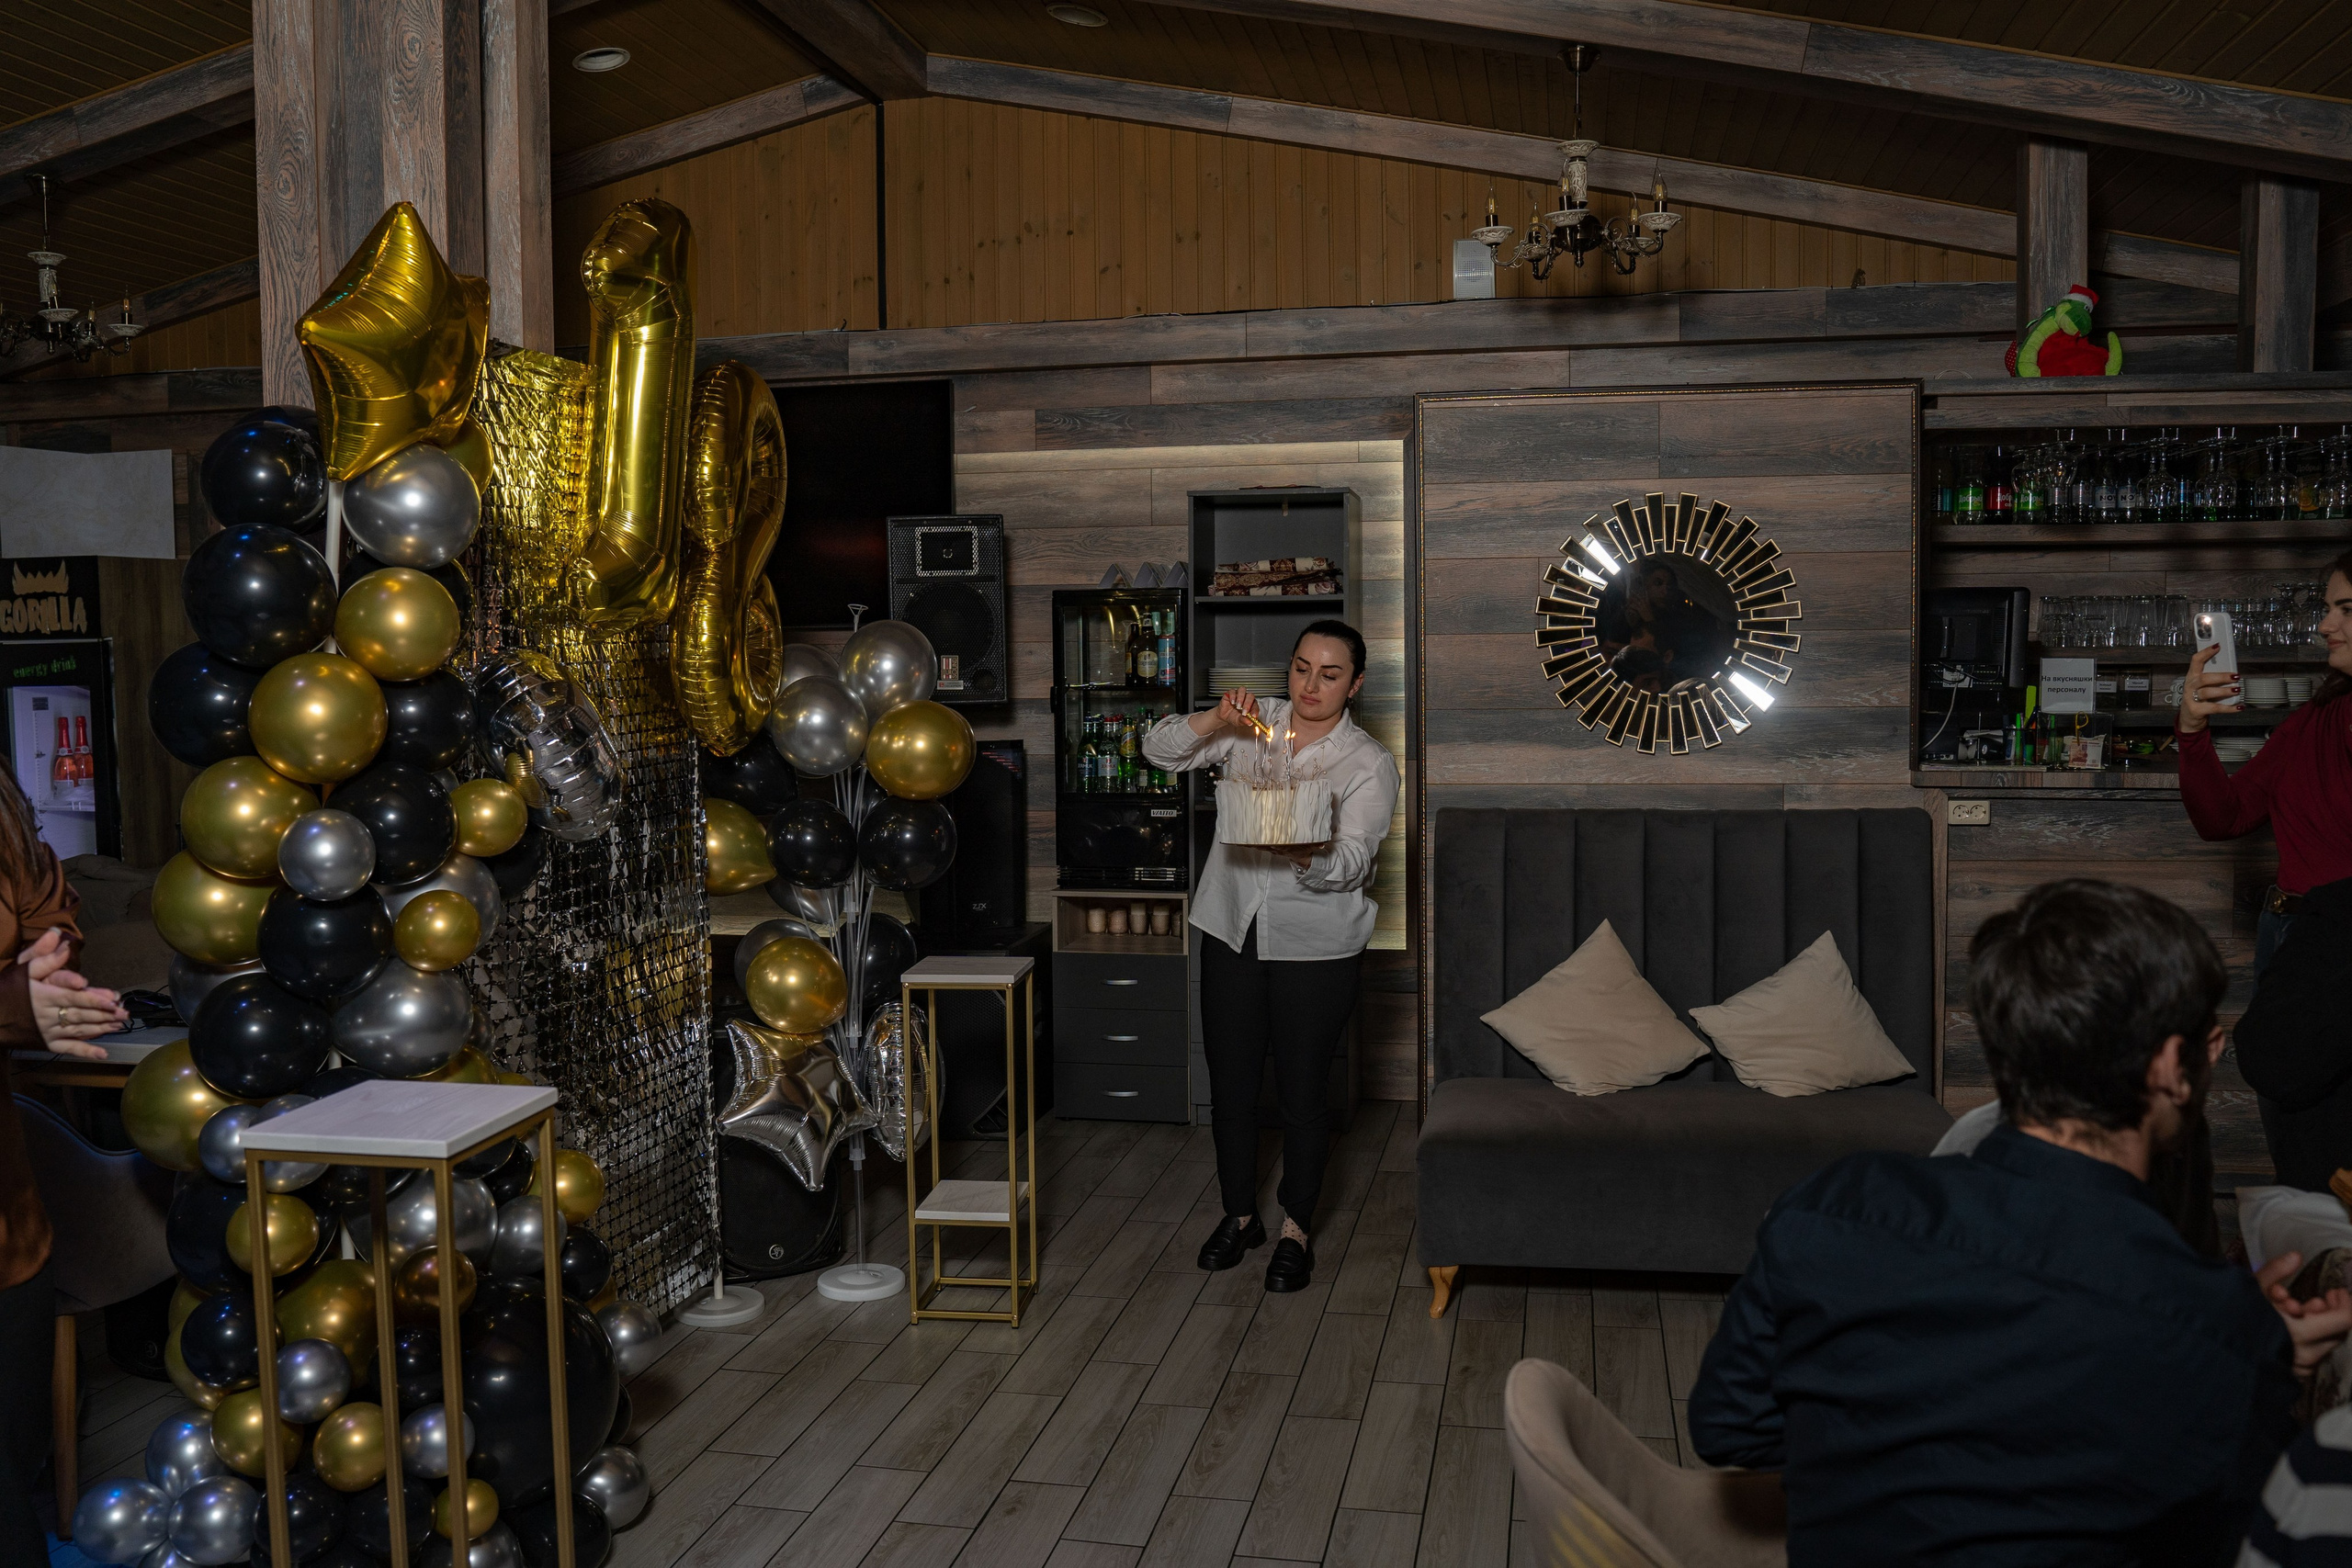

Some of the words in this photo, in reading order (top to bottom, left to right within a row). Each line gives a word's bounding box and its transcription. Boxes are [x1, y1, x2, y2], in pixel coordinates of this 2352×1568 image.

[0, 595, 87, 635] GORILLA
[13, 663, 48, 678] energy
[51, 655, 76, 674] drink
